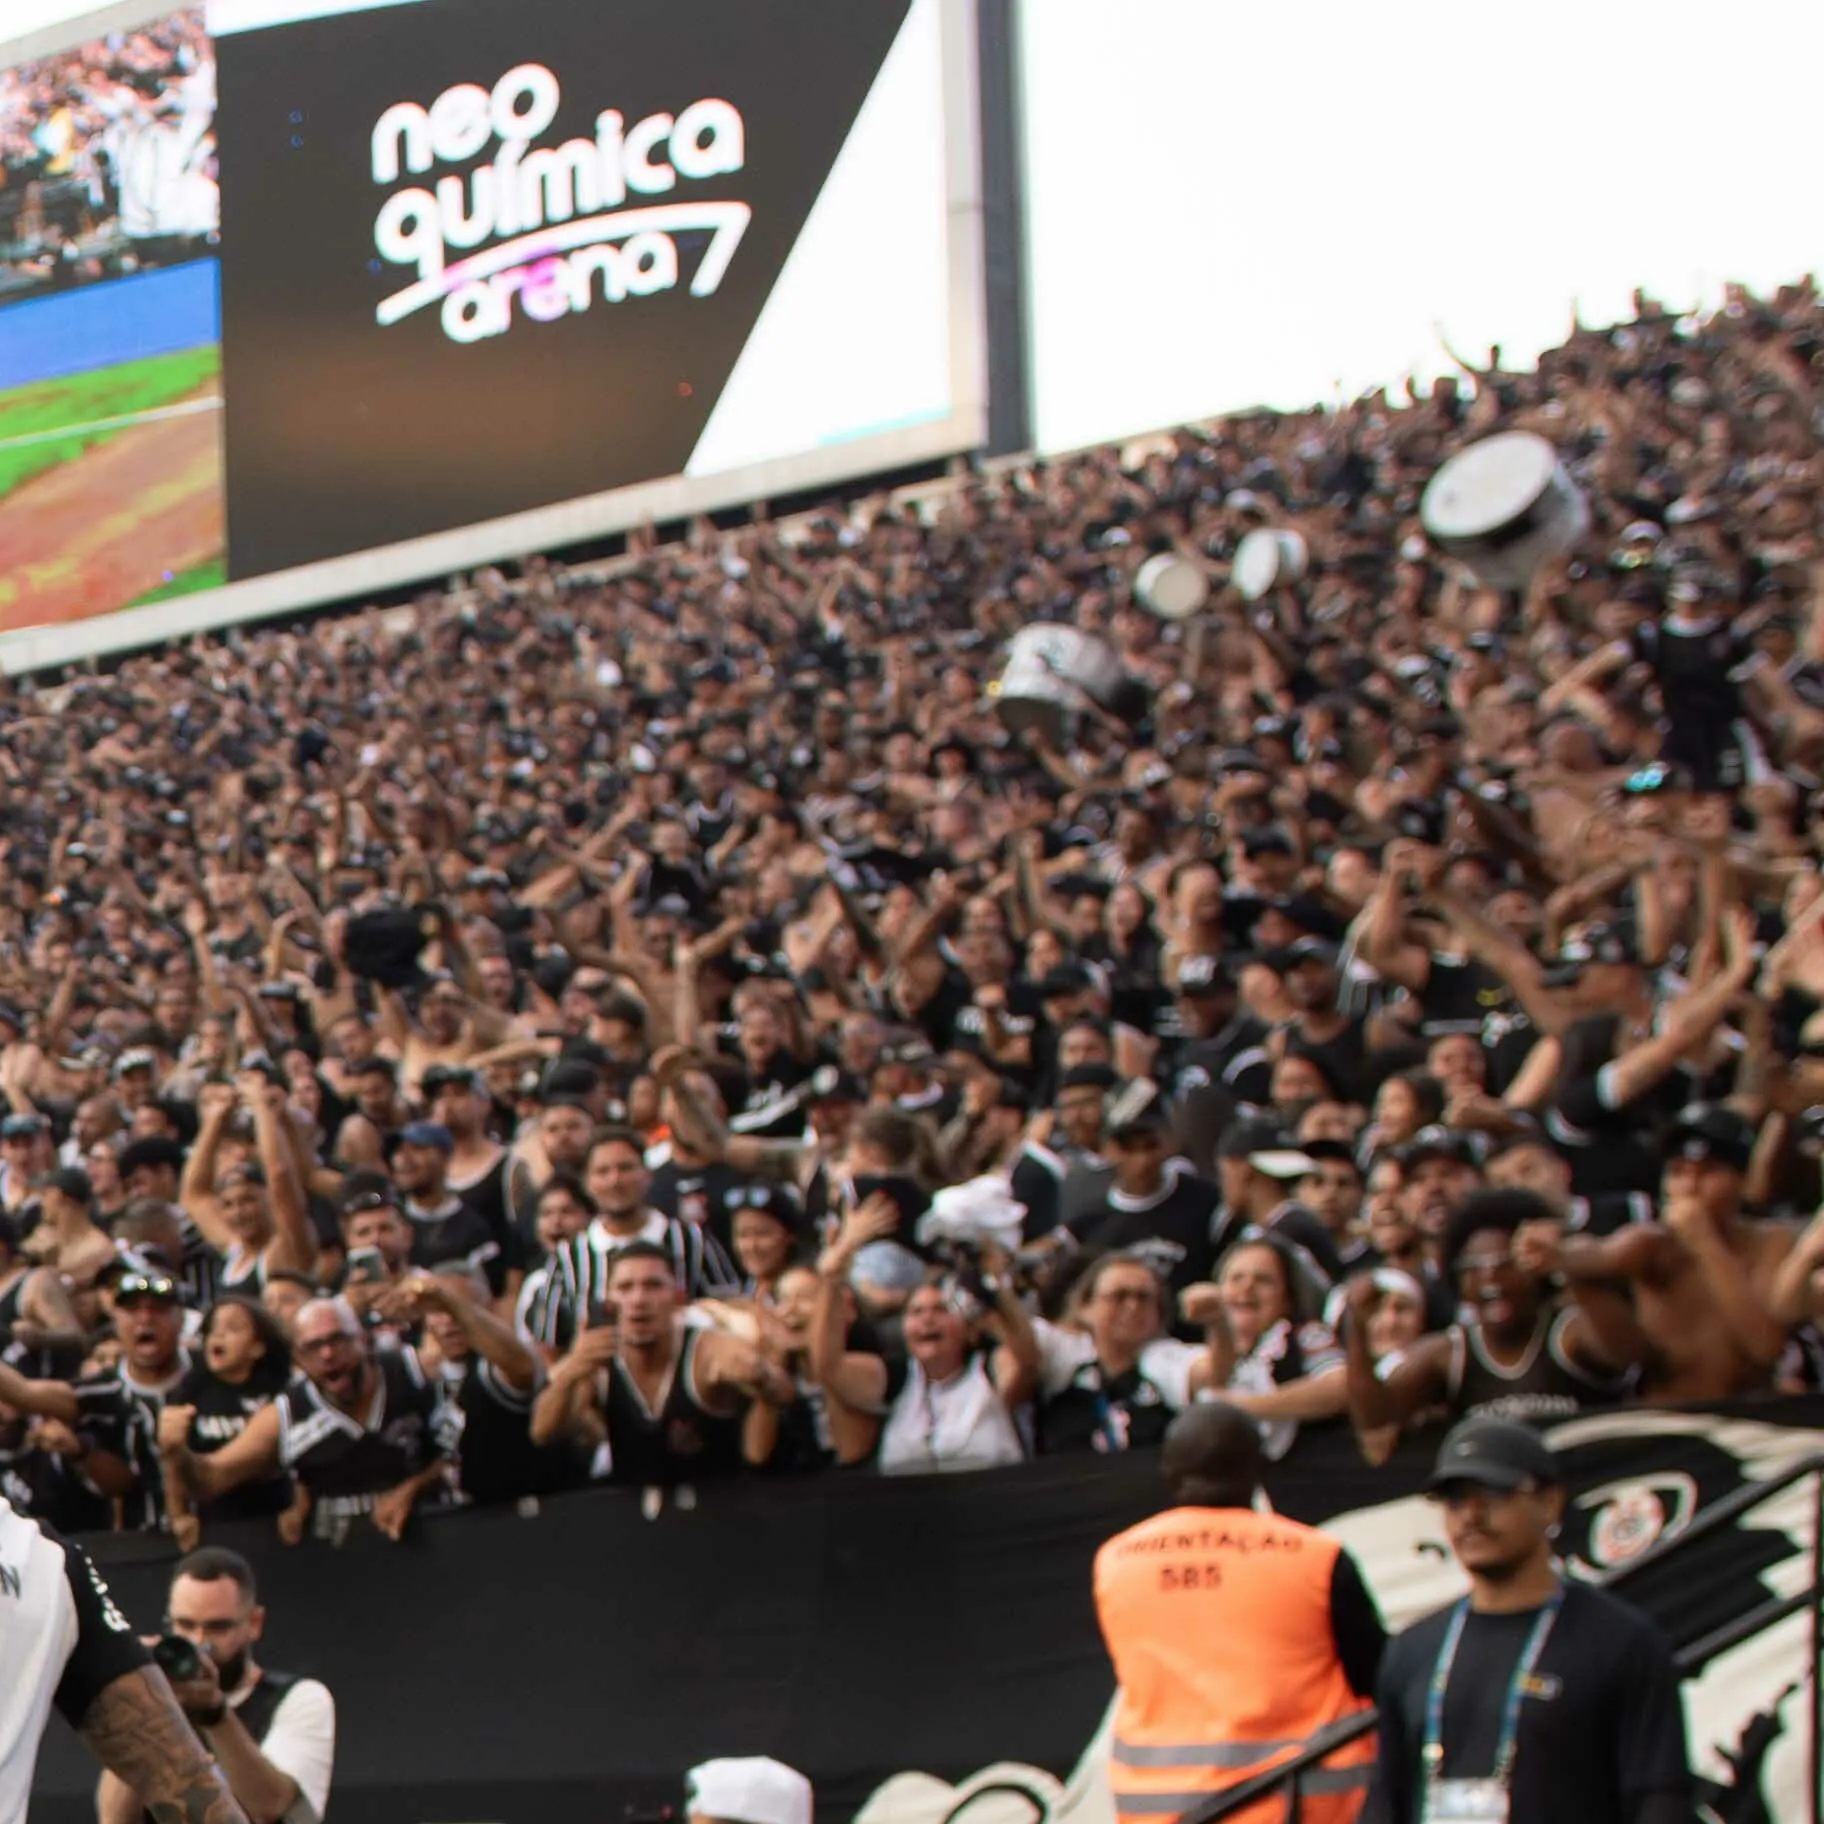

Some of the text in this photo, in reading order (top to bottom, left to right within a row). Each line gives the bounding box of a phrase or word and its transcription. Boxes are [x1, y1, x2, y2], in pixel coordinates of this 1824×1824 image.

[371, 64, 560, 184] neo
[374, 98, 745, 280] química
[440, 232, 678, 343] arena
